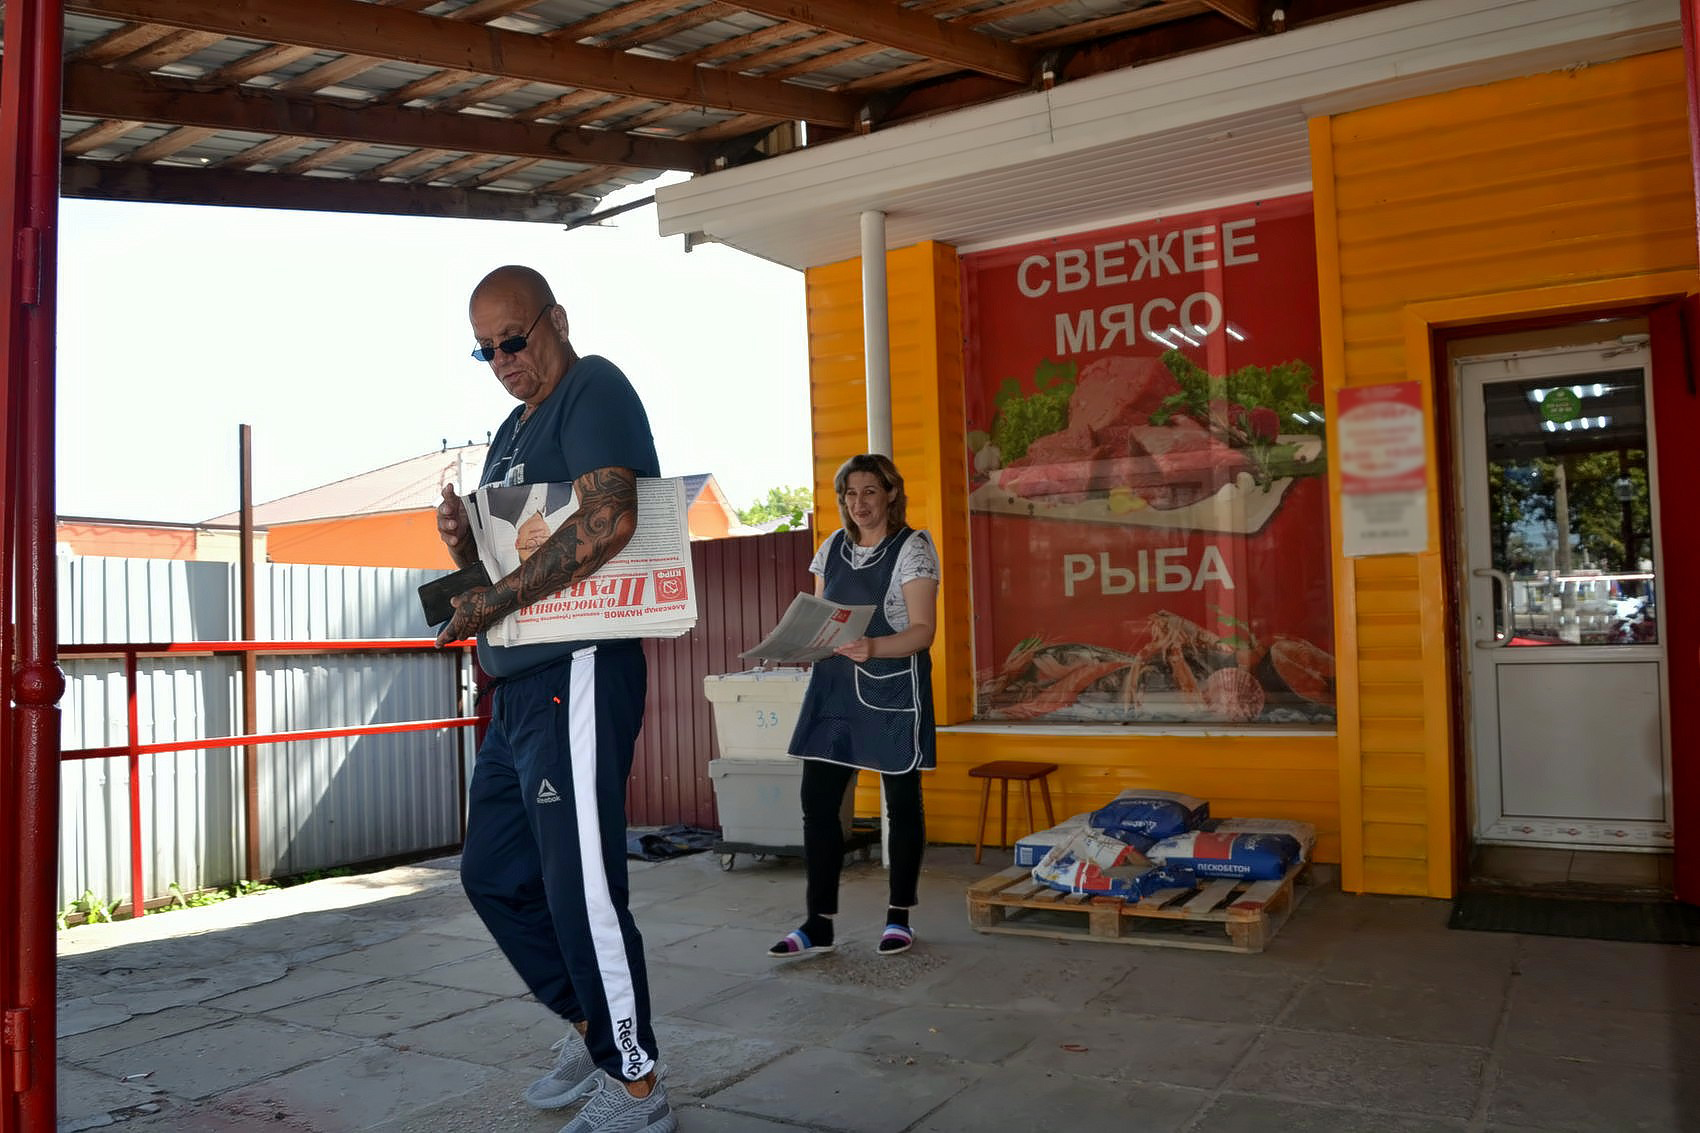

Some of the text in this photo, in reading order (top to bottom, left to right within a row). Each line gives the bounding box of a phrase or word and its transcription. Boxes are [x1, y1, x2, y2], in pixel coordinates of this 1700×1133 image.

[1016, 217, 1259, 297] СВЕЖЕЕ
[1055, 292, 1223, 355] МЯСО
[656, 568, 681, 578] КПРФ
[1062, 545, 1236, 597] РЫБА
[604, 609, 643, 620] НАУМОВ
[644, 603, 686, 615] Александр
[1196, 862, 1251, 873] ПЕСКОБЕТОН
